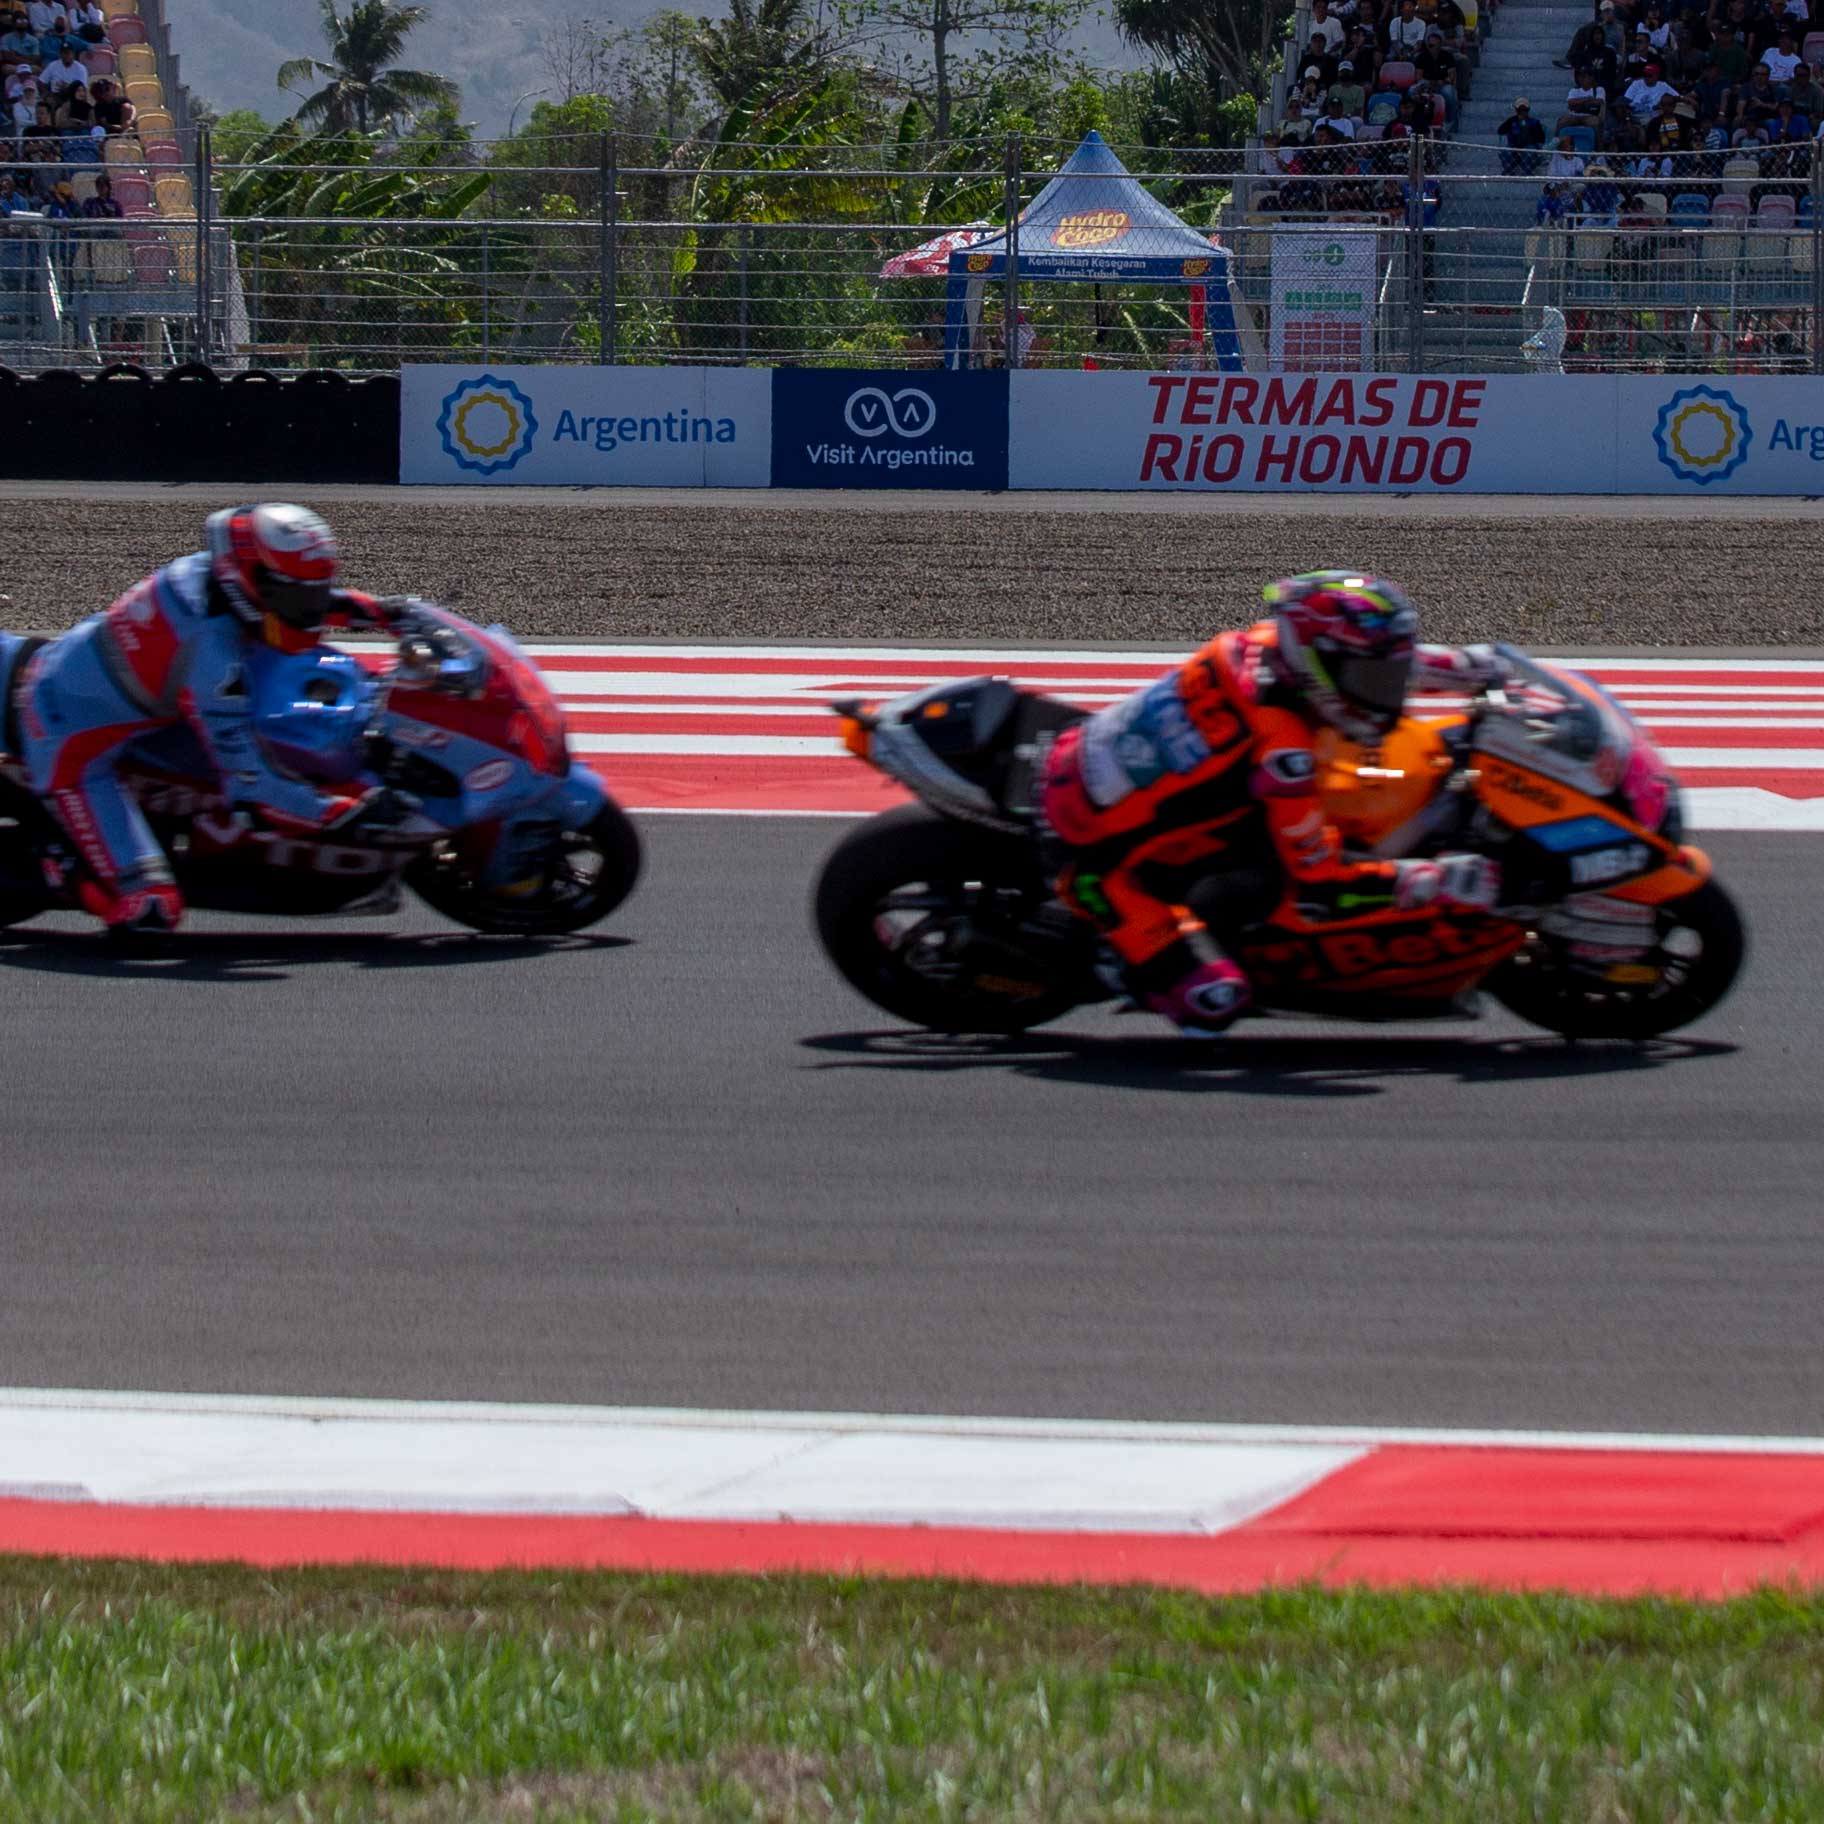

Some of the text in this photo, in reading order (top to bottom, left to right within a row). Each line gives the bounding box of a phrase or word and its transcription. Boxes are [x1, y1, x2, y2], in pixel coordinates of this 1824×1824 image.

[1059, 212, 1128, 234] Hydro
[1056, 227, 1116, 246] Coco
[1028, 257, 1146, 270] Kembalikan Kesegaran
[1055, 268, 1085, 277] Alami
[1148, 376, 1487, 427] TERMAS DE
[553, 409, 736, 452] Argentina
[806, 444, 974, 469] Visit Argentina
[1254, 435, 1471, 485] HONDO
